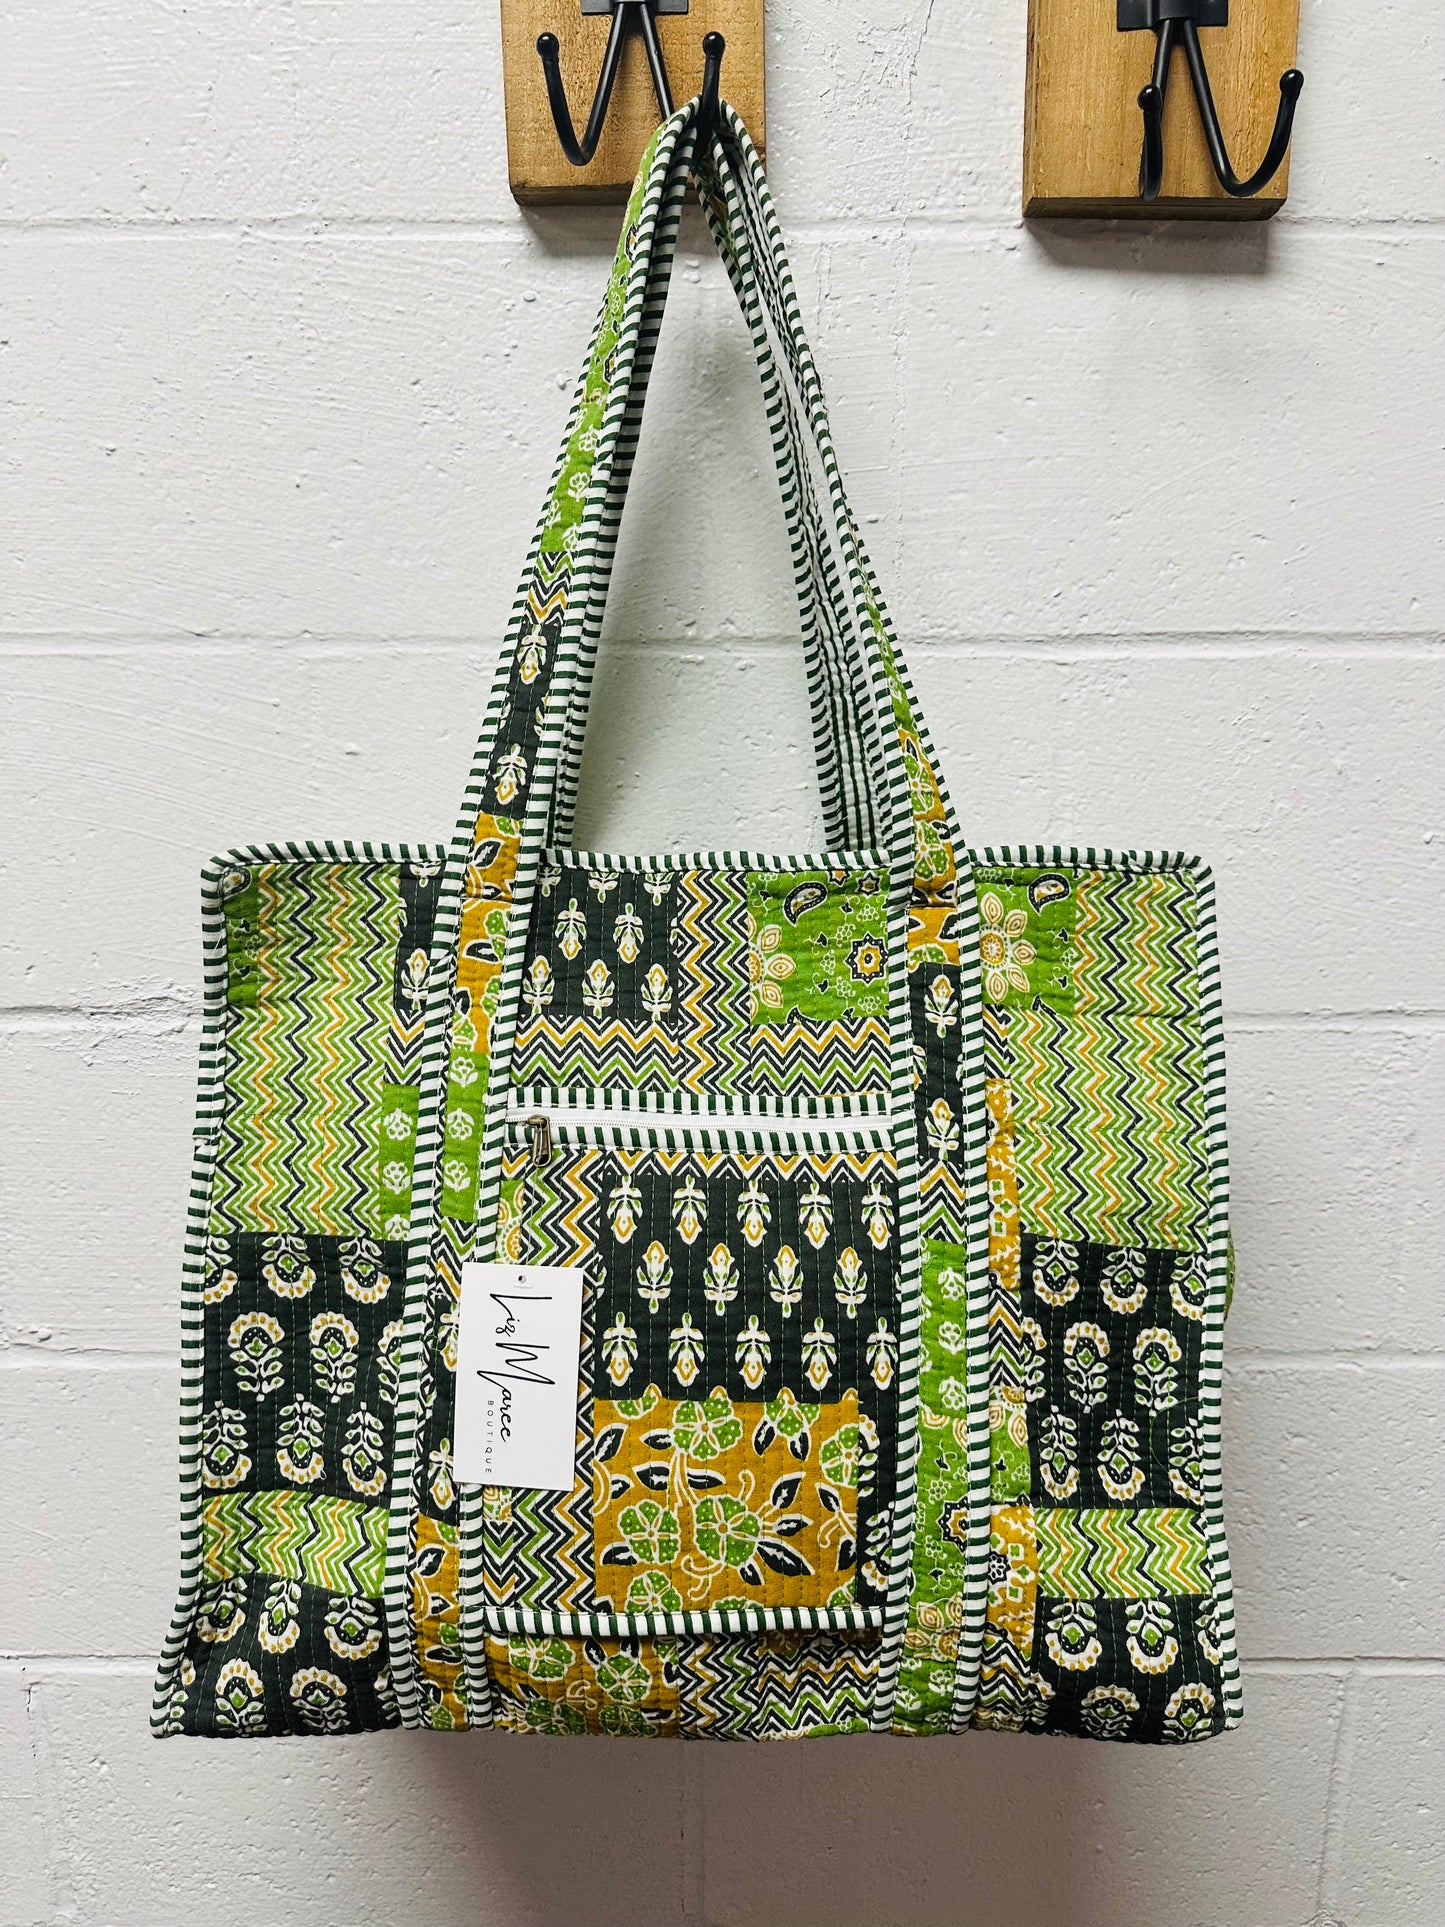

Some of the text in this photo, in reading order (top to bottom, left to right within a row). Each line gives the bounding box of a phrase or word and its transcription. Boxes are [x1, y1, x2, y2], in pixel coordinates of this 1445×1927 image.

[476, 1293, 556, 1443] Liz Maree
[484, 1400, 494, 1474] BOUTIQUE
